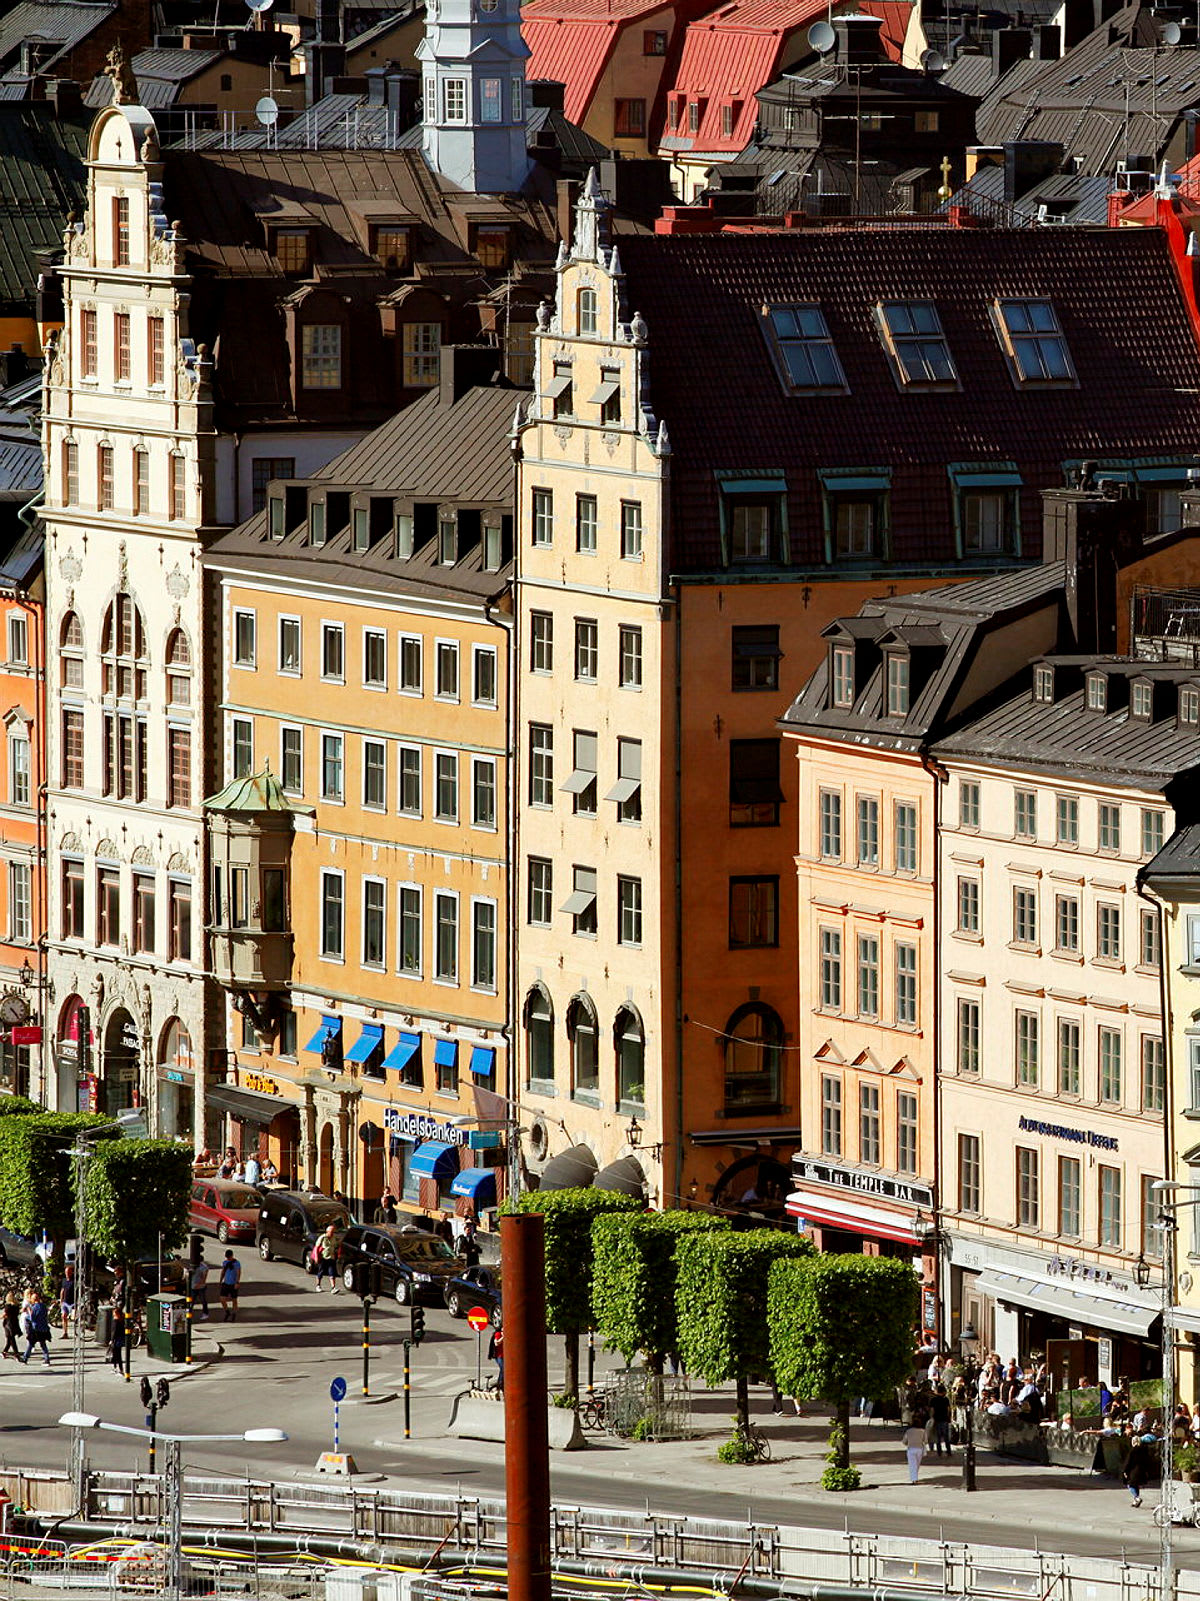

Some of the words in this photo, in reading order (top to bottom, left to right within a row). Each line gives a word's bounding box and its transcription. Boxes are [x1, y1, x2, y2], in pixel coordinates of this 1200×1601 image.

[383, 1108, 464, 1145] Handelsbanken
[848, 1173, 884, 1194] TEMPLE
[894, 1184, 913, 1201] BAR
